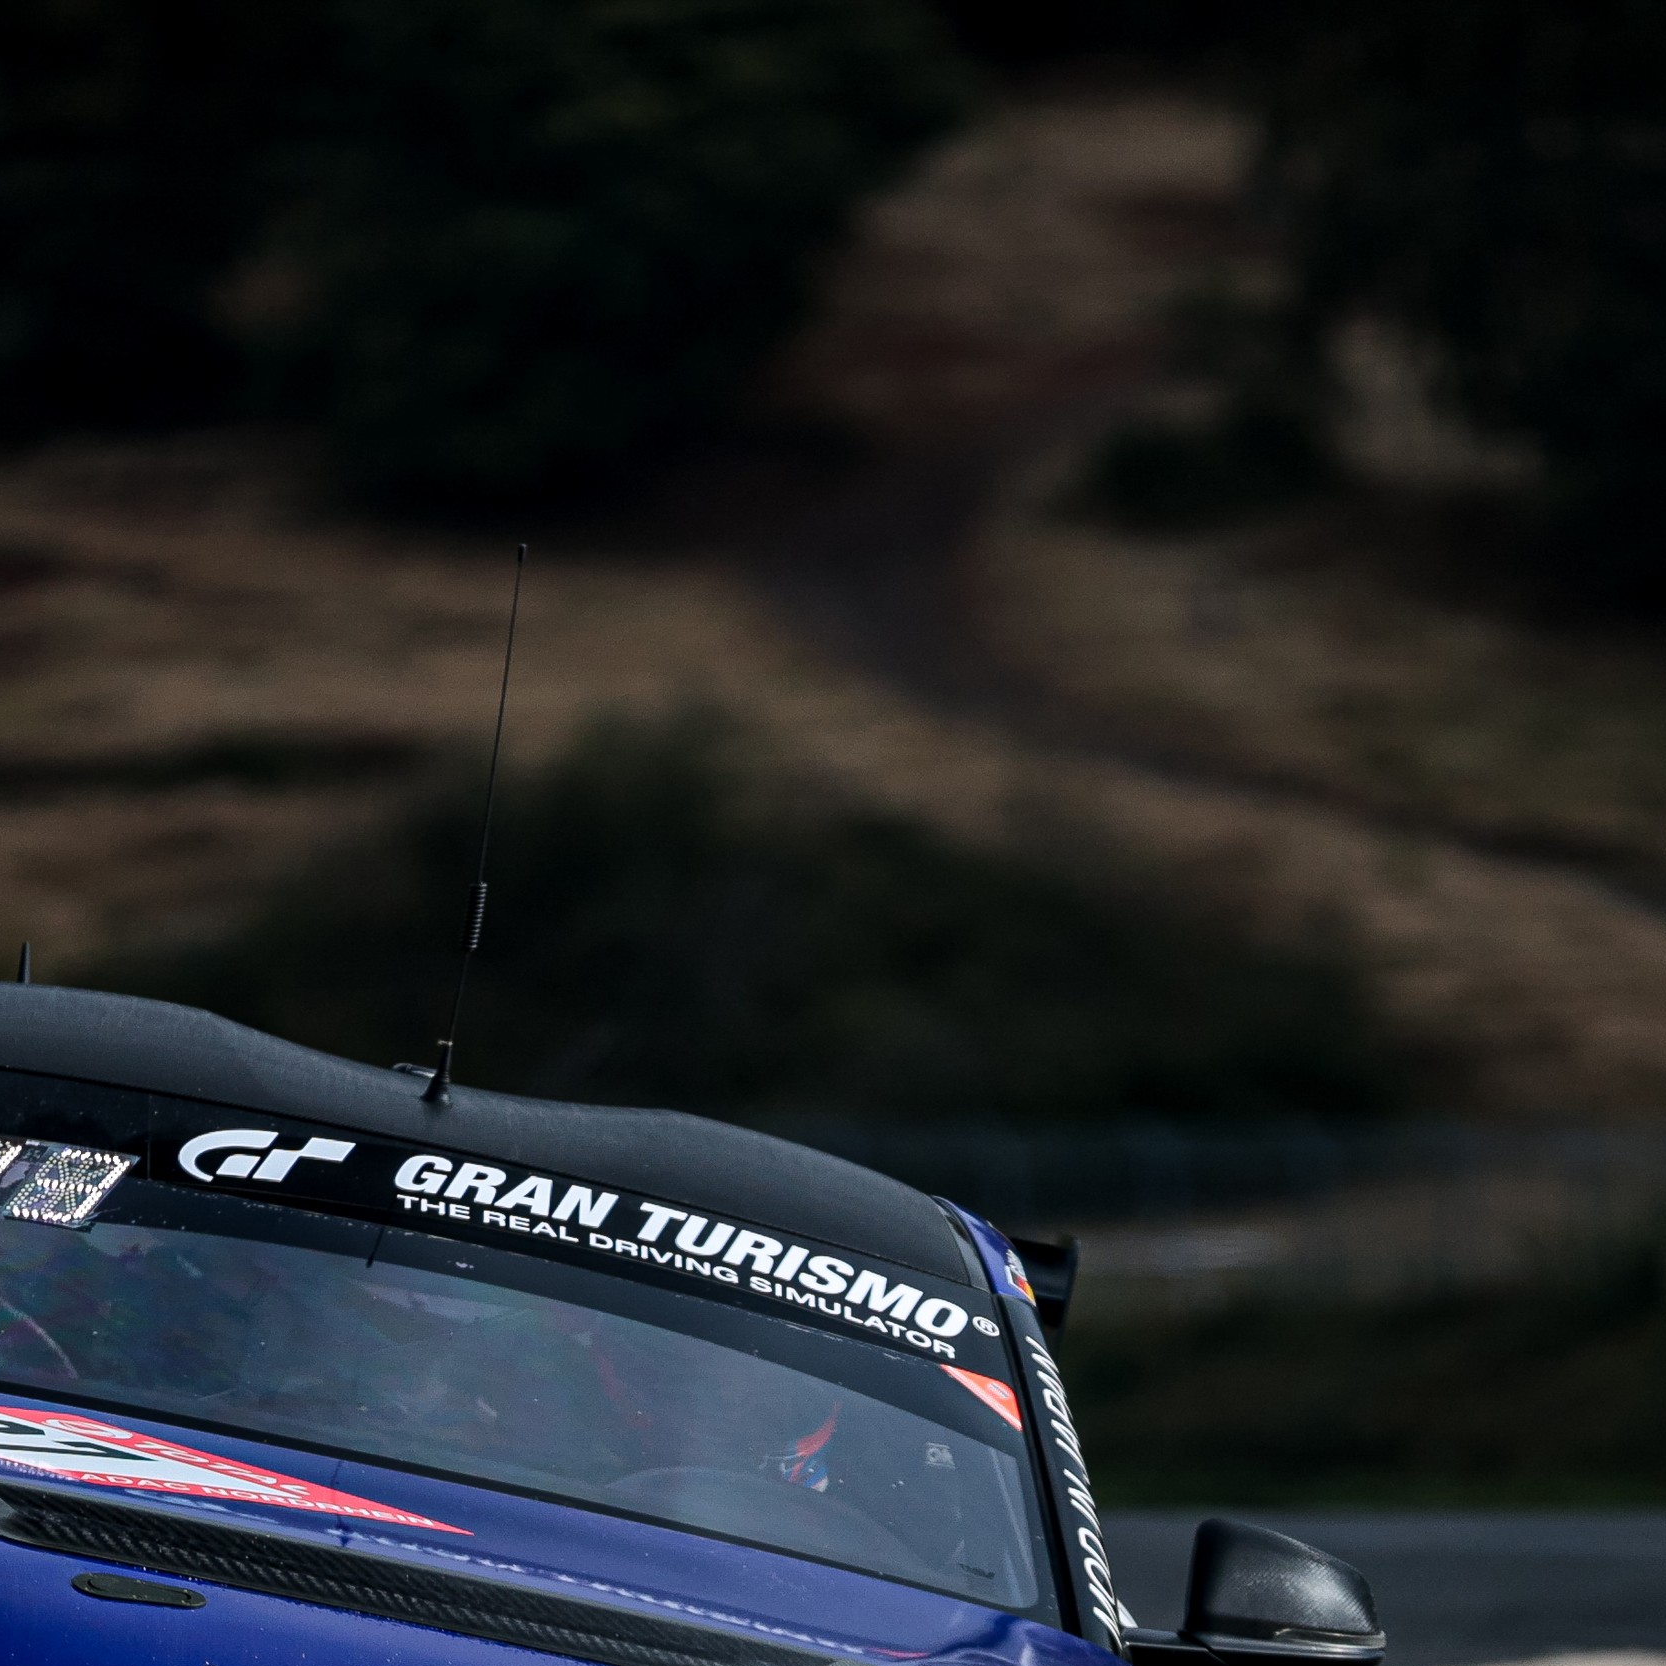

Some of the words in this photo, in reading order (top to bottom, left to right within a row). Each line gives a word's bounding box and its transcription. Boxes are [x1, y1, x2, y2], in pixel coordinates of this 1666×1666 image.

[393, 1155, 619, 1228] GRAN
[397, 1194, 471, 1220] THE
[483, 1210, 579, 1243] REAL
[589, 1233, 739, 1284] DRIVING
[750, 1275, 956, 1360] SIMULATOR
[80, 1473, 190, 1492] ADAC
[204, 1487, 435, 1527] NORDRHEIN
[134, 1440, 311, 1497] TOTAL
